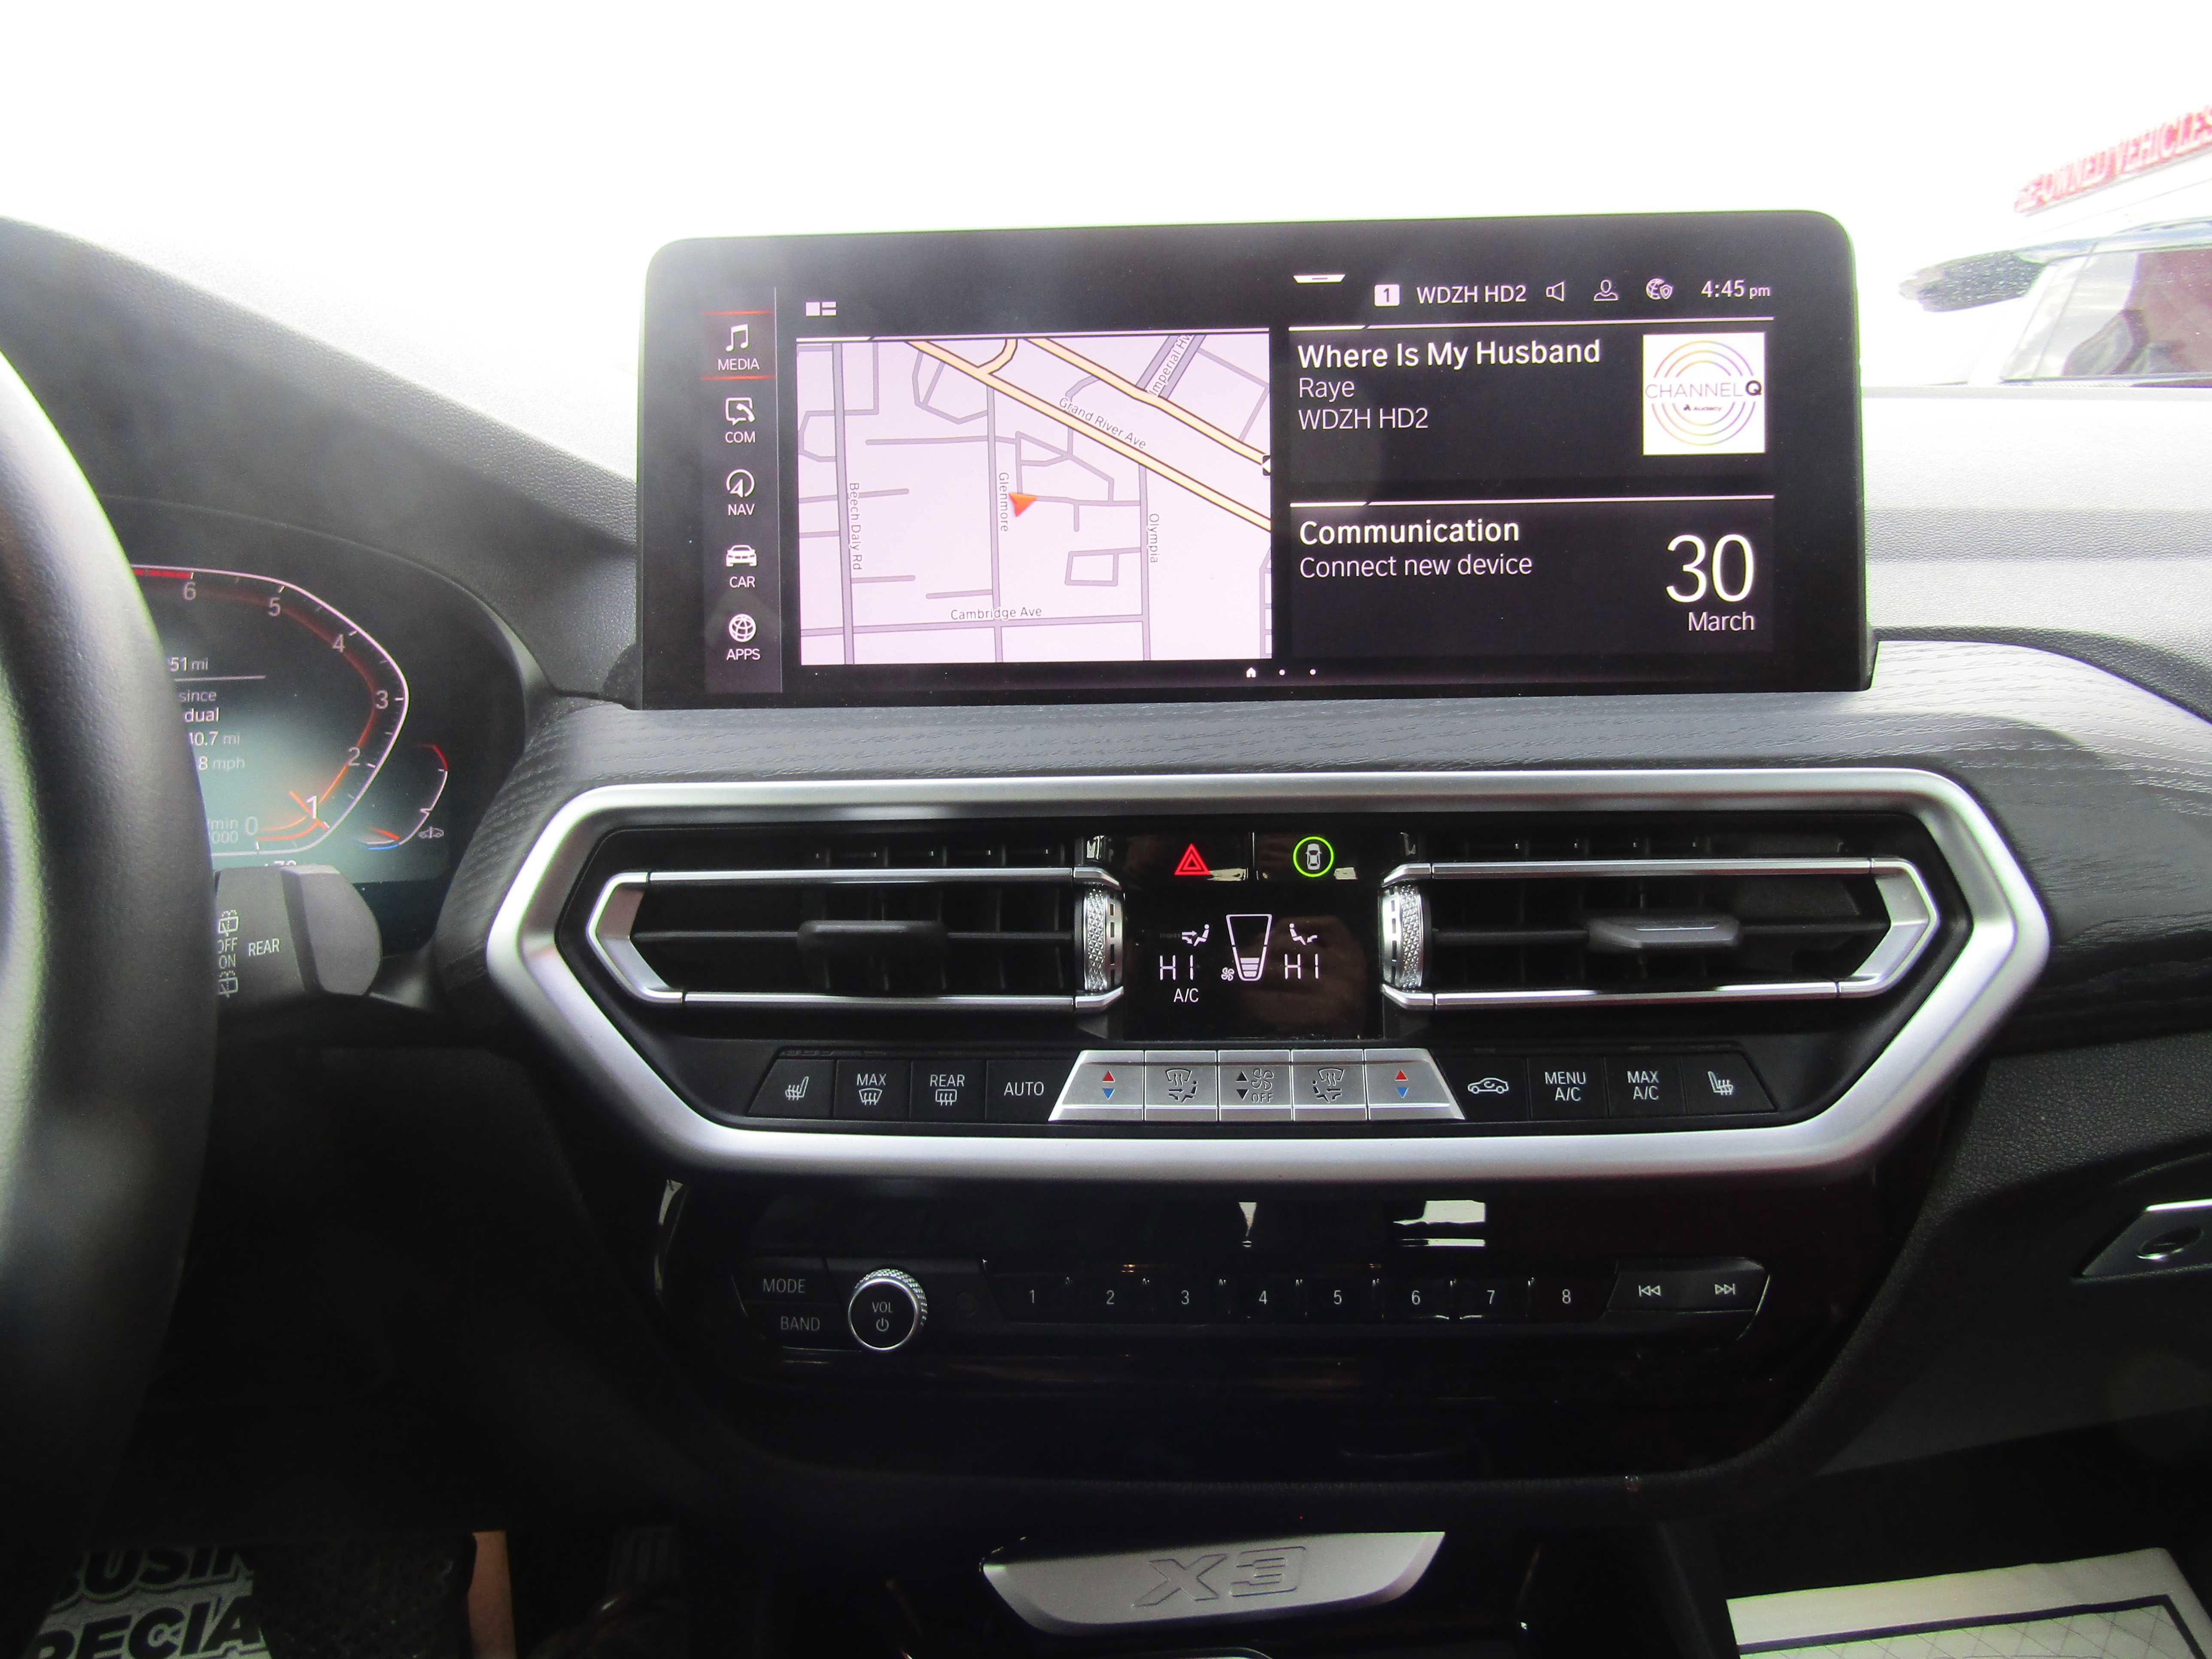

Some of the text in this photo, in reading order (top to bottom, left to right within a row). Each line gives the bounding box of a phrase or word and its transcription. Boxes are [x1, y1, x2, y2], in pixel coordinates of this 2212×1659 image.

[1383, 288, 1390, 303] 1
[1417, 285, 1527, 304] WDZH HD2
[1701, 280, 1771, 300] 4:45 pm
[1297, 339, 1601, 370] Where Is My Husband
[717, 358, 760, 371] MEDIA
[1149, 349, 1181, 396] Imperial
[1299, 378, 1355, 402] Raye
[1645, 380, 1762, 399] CHANNEL Q
[1059, 397, 1146, 449] Grand River Ave
[1298, 407, 1429, 430] WDZH HD2
[724, 431, 756, 444] COM
[727, 503, 754, 516] NAV
[999, 472, 1009, 532] Glenmore
[849, 482, 863, 571] Beech Daly Rd
[1299, 519, 1520, 545] Communication
[1147, 513, 1160, 563] Olympia
[1300, 554, 1533, 578] Connect new device
[1666, 534, 1755, 603] 30
[729, 576, 756, 588] CAR
[182, 582, 197, 601] 6
[267, 597, 282, 617] 5
[950, 606, 1042, 621] Cambridge Ave
[1688, 611, 1755, 632] March
[332, 634, 346, 653] 4
[726, 648, 760, 661] APPS
[167, 656, 209, 672] 51 mi
[179, 689, 217, 702] since
[375, 690, 389, 709] 3
[184, 707, 220, 723] dual
[223, 732, 240, 745] mi
[213, 757, 245, 771] mph
[347, 747, 361, 766] 2
[307, 794, 319, 819] 1
[245, 816, 258, 836] 0
[249, 938, 280, 956] REAR
[219, 954, 236, 969] ON
[1173, 988, 1199, 1003] A/C
[856, 1073, 887, 1086] MAX
[930, 1074, 965, 1088] REAR
[1545, 1072, 1586, 1085] MENU
[1627, 1070, 1659, 1084] MAX
[1003, 1082, 1045, 1097] AUTO
[1251, 1092, 1274, 1103] OFF
[1554, 1087, 1581, 1102] A/C
[1632, 1085, 1659, 1101] A/C
[763, 1279, 806, 1294] MODE
[1029, 1290, 1035, 1304] 1
[1106, 1290, 1115, 1305] 2
[1181, 1290, 1190, 1305] 3
[1258, 1289, 1268, 1305] 4
[1333, 1289, 1343, 1305] 5
[1411, 1289, 1421, 1305] 6
[1486, 1289, 1496, 1305] 7
[1562, 1289, 1572, 1304] 8
[871, 1301, 894, 1313] VOL
[780, 1316, 820, 1331] BAND
[1132, 1546, 1307, 1607] X3
